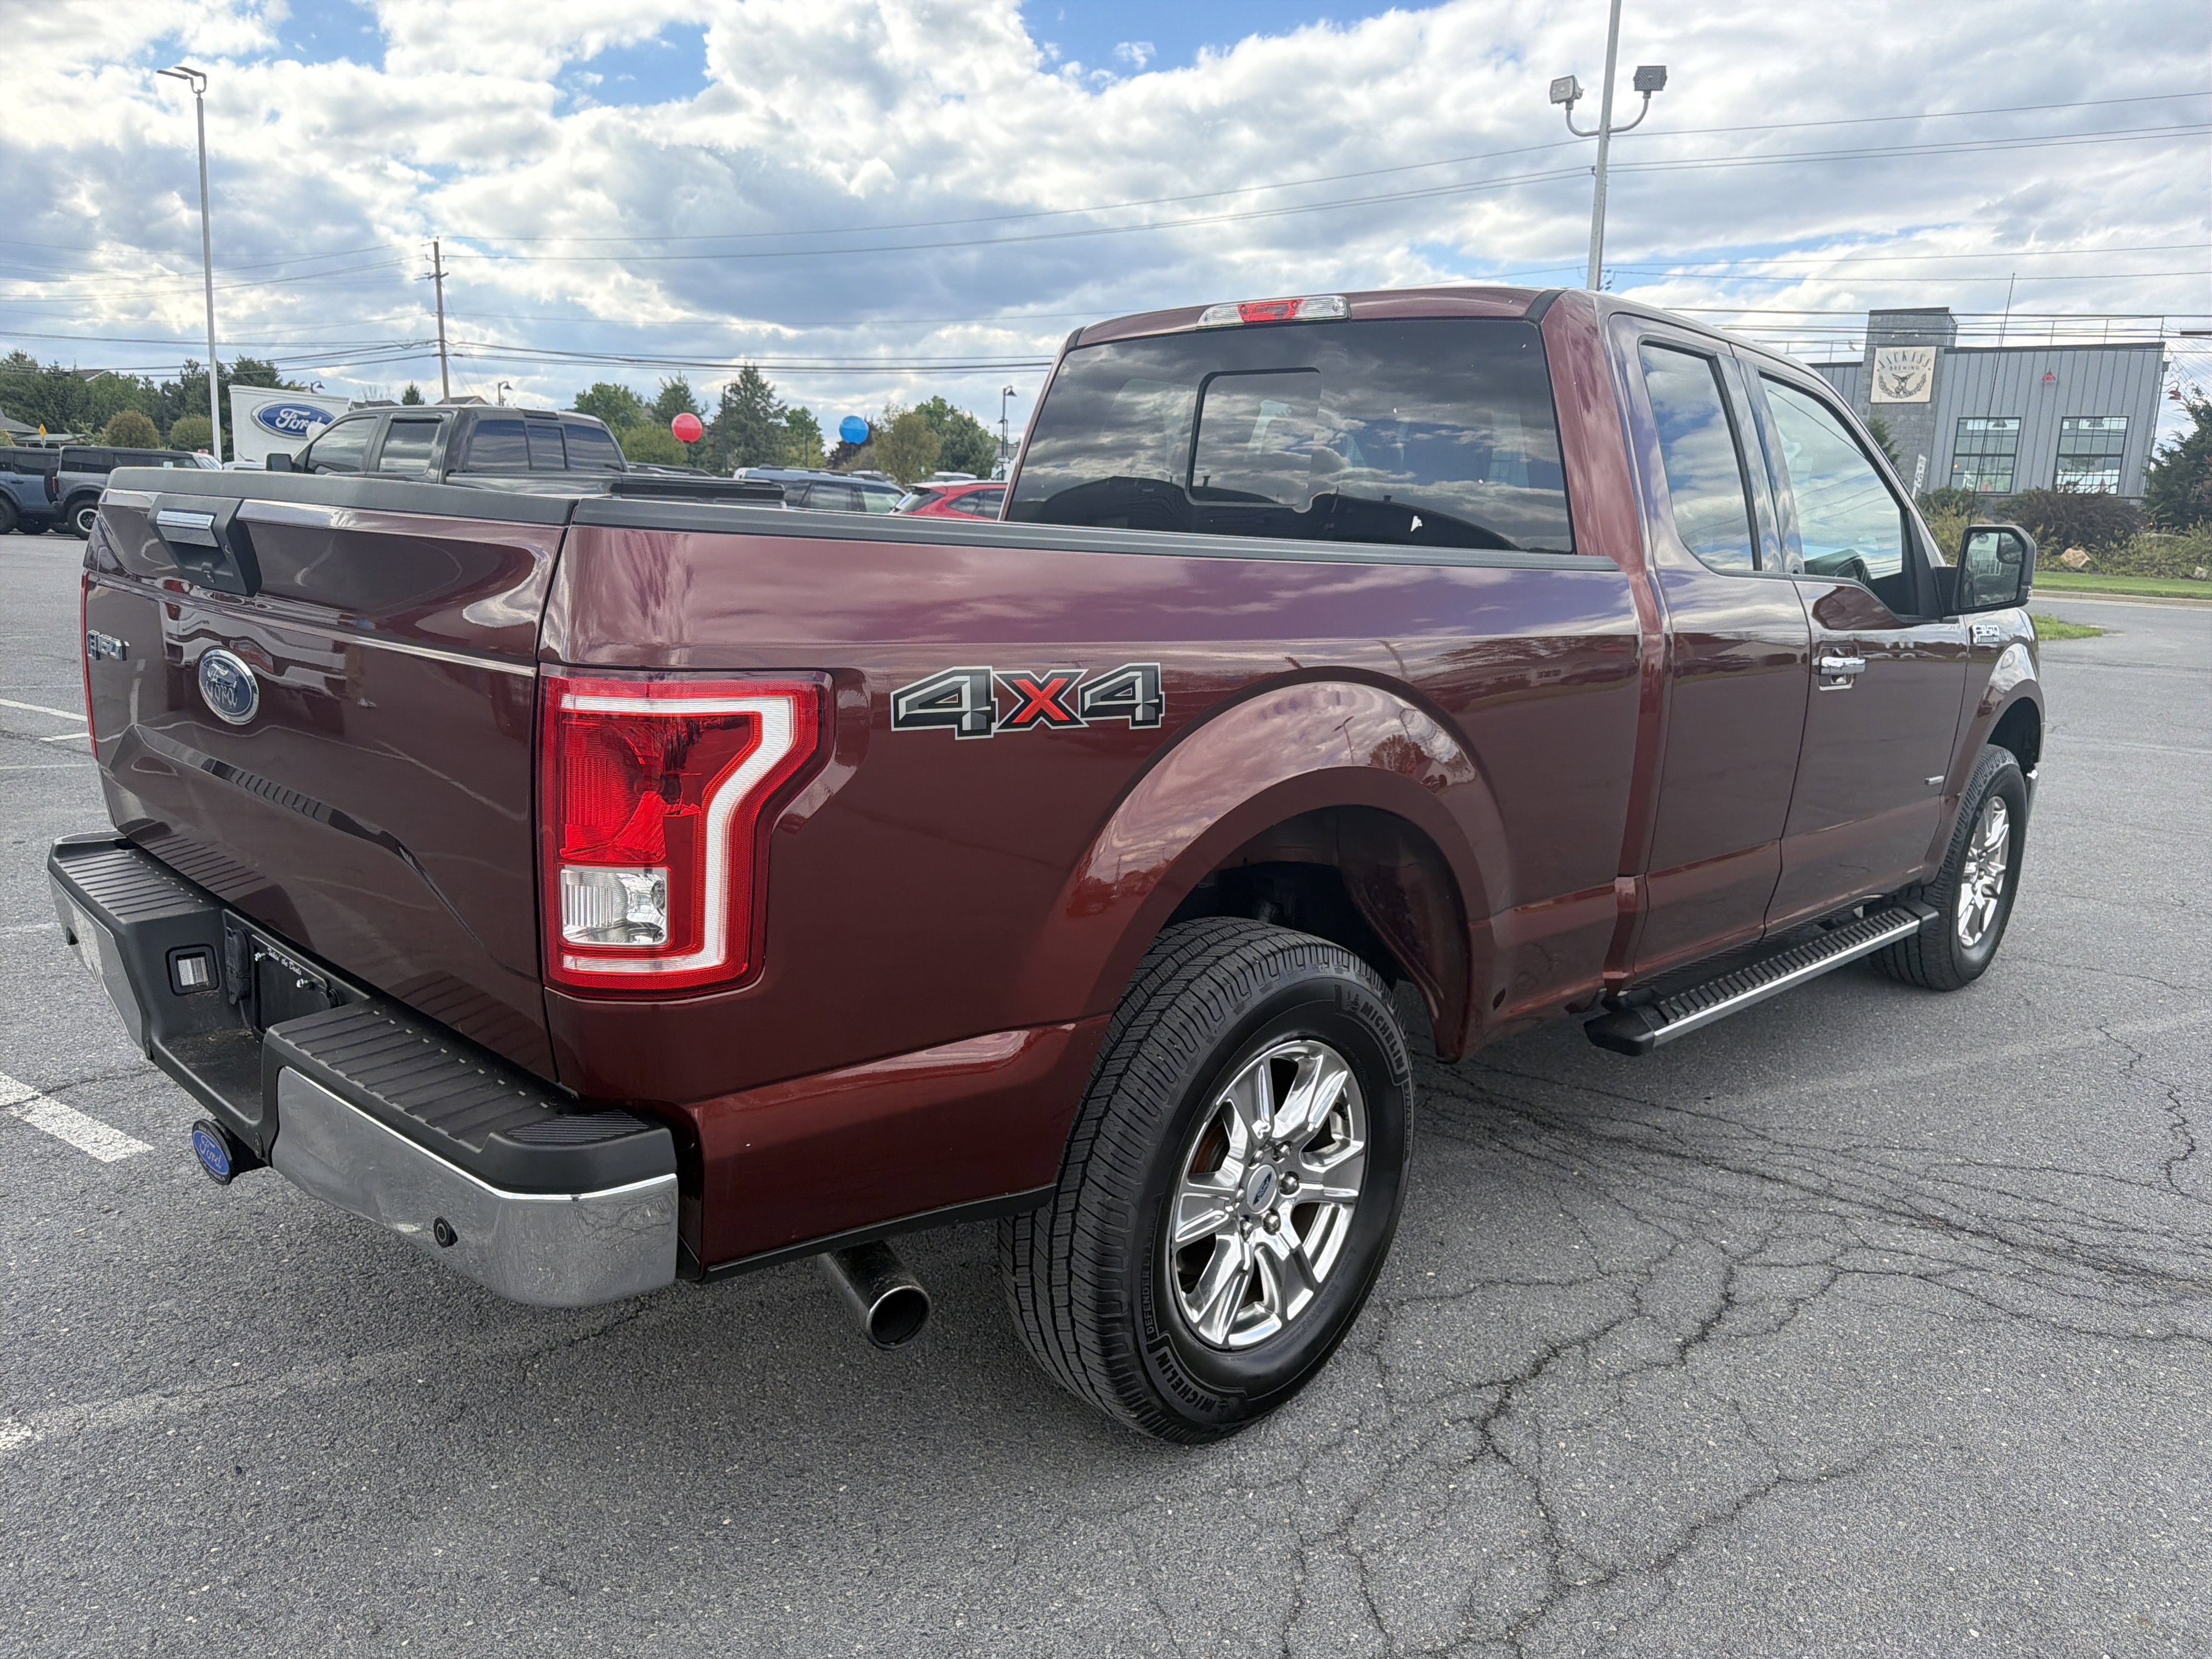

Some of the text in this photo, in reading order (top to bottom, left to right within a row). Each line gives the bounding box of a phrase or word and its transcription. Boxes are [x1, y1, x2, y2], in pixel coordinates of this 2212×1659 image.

[205, 661, 239, 707] Ford
[1360, 1001, 1404, 1070] MICHELIN
[199, 1135, 222, 1169] Ford
[1142, 1268, 1154, 1335] DEFENDER
[1155, 1351, 1217, 1413] MICHELIN
